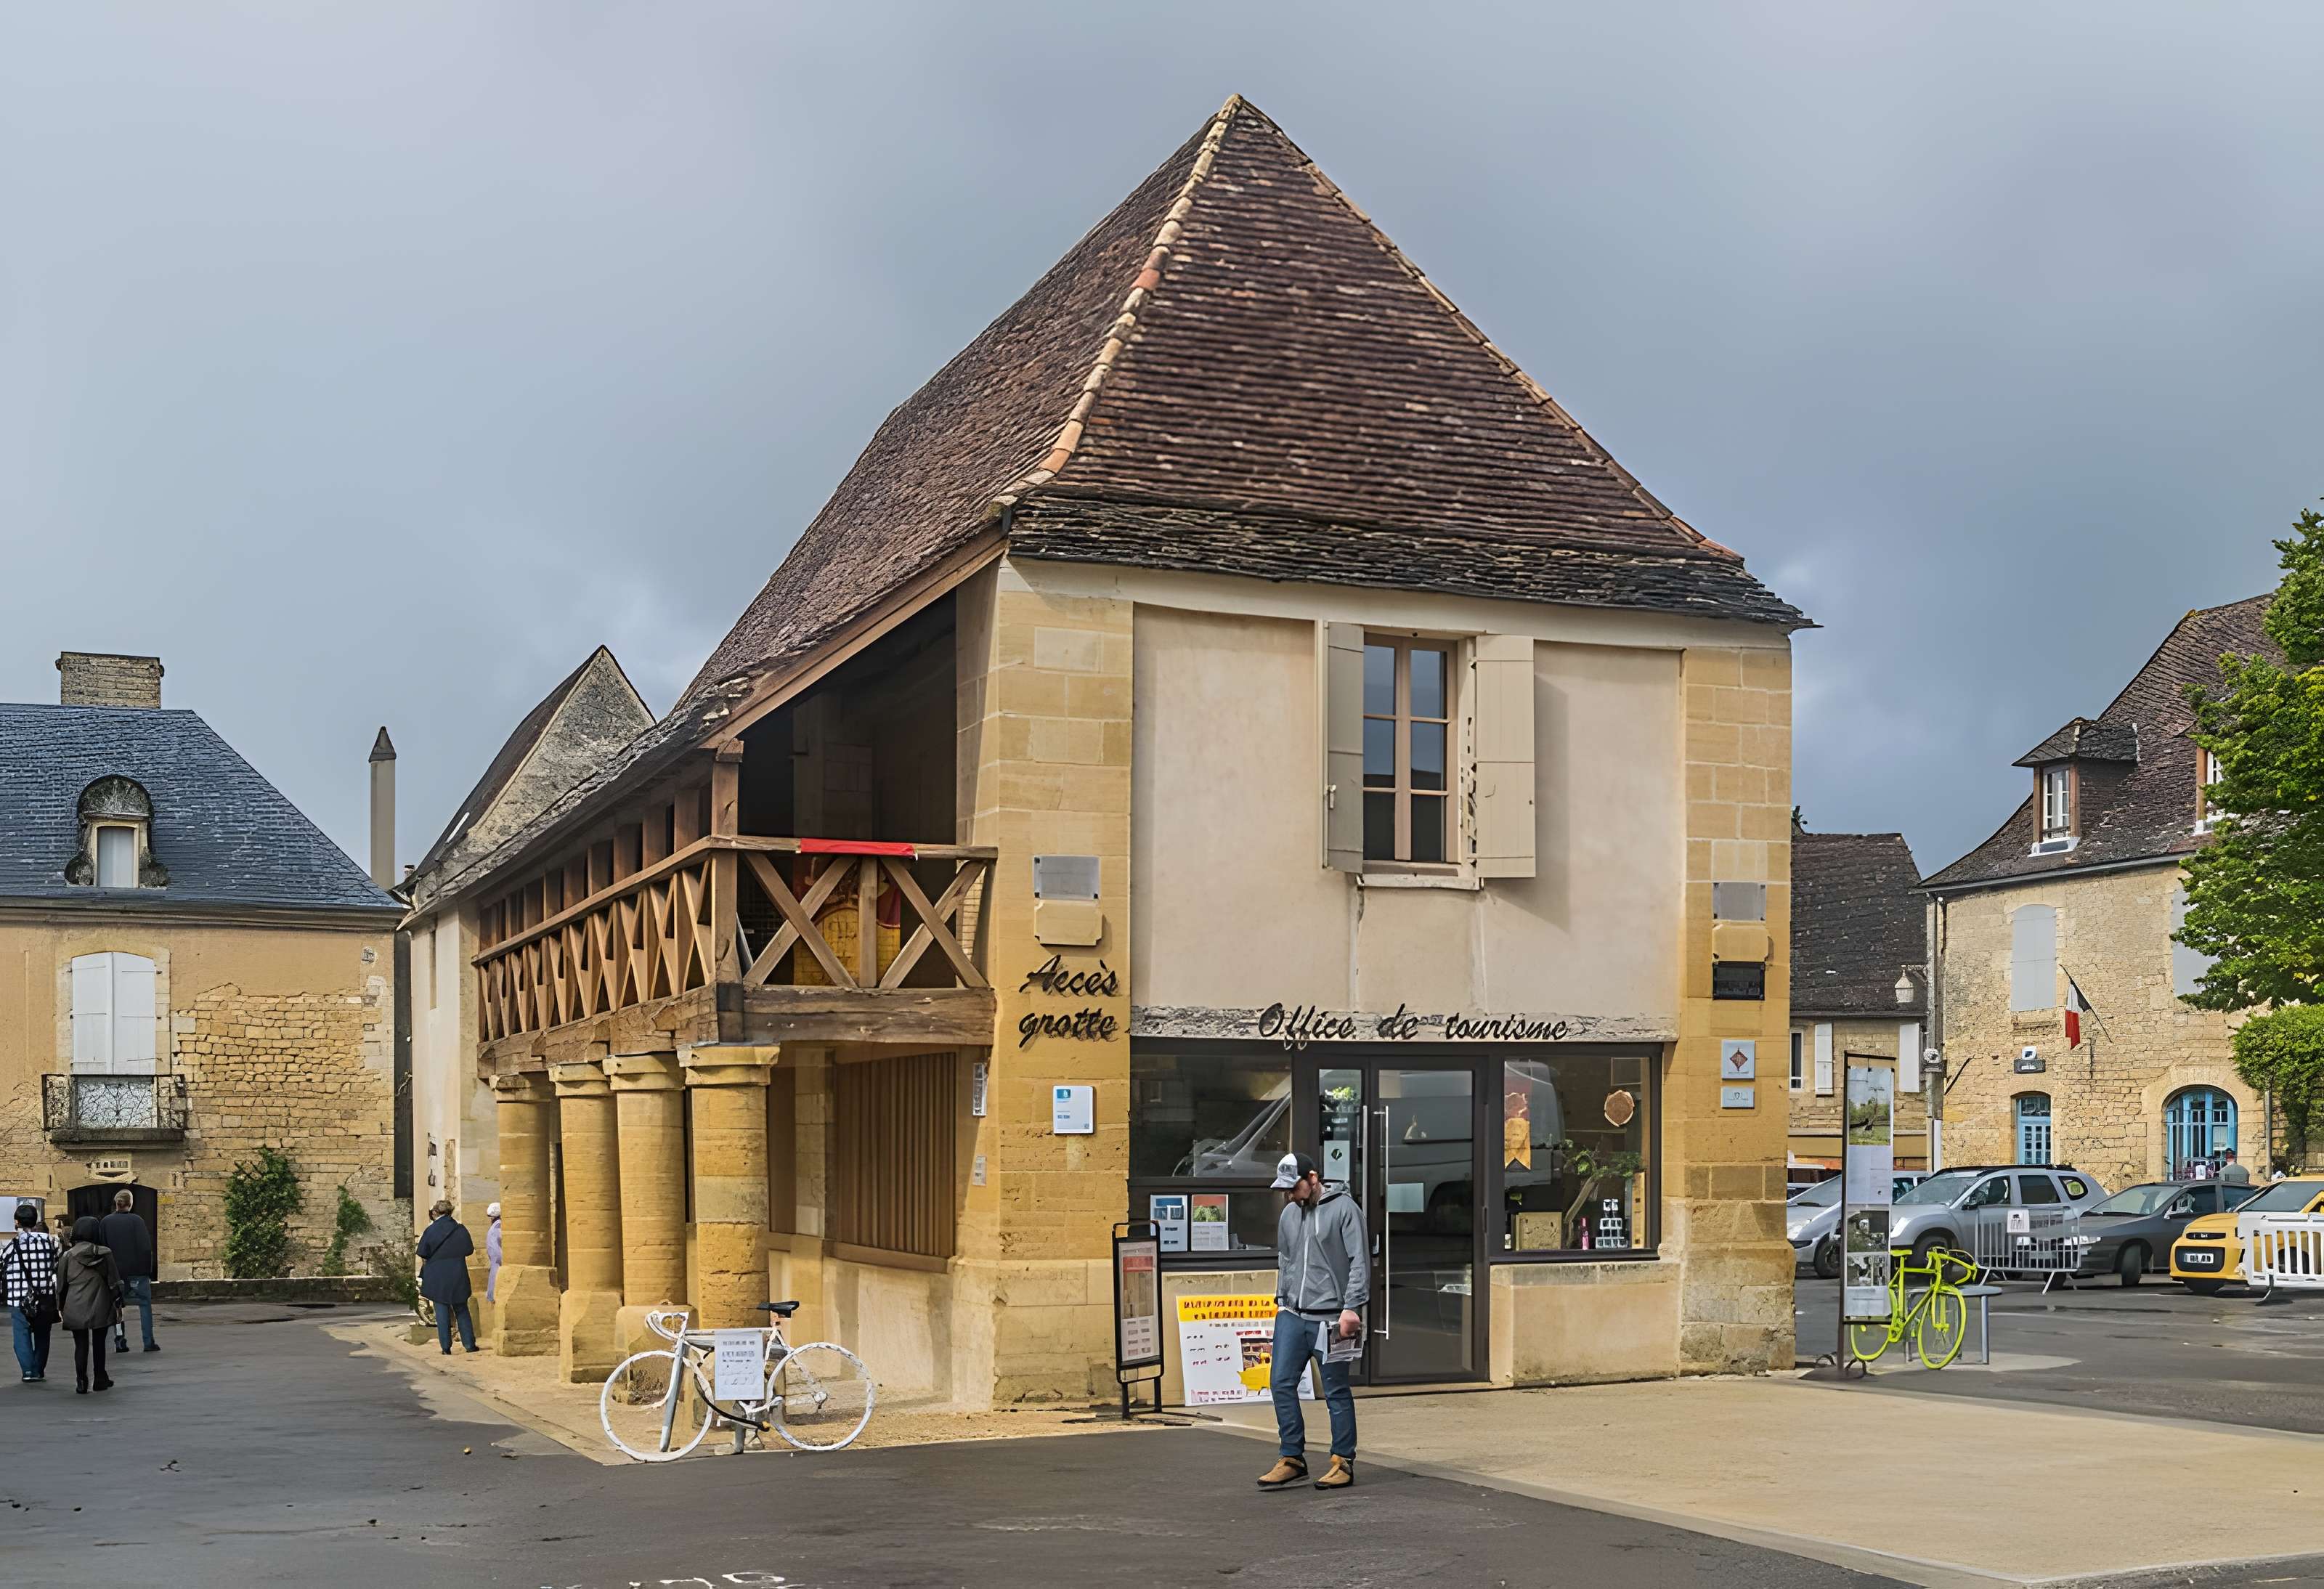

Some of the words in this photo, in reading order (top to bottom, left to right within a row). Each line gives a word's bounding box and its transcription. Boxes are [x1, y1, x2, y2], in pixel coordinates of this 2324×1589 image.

[1019, 954, 1118, 997] Accès
[1019, 1008, 1118, 1047] grotte
[1259, 1002, 1357, 1051] Office
[1377, 1003, 1418, 1039] de
[1445, 1012, 1567, 1040] tourisme
